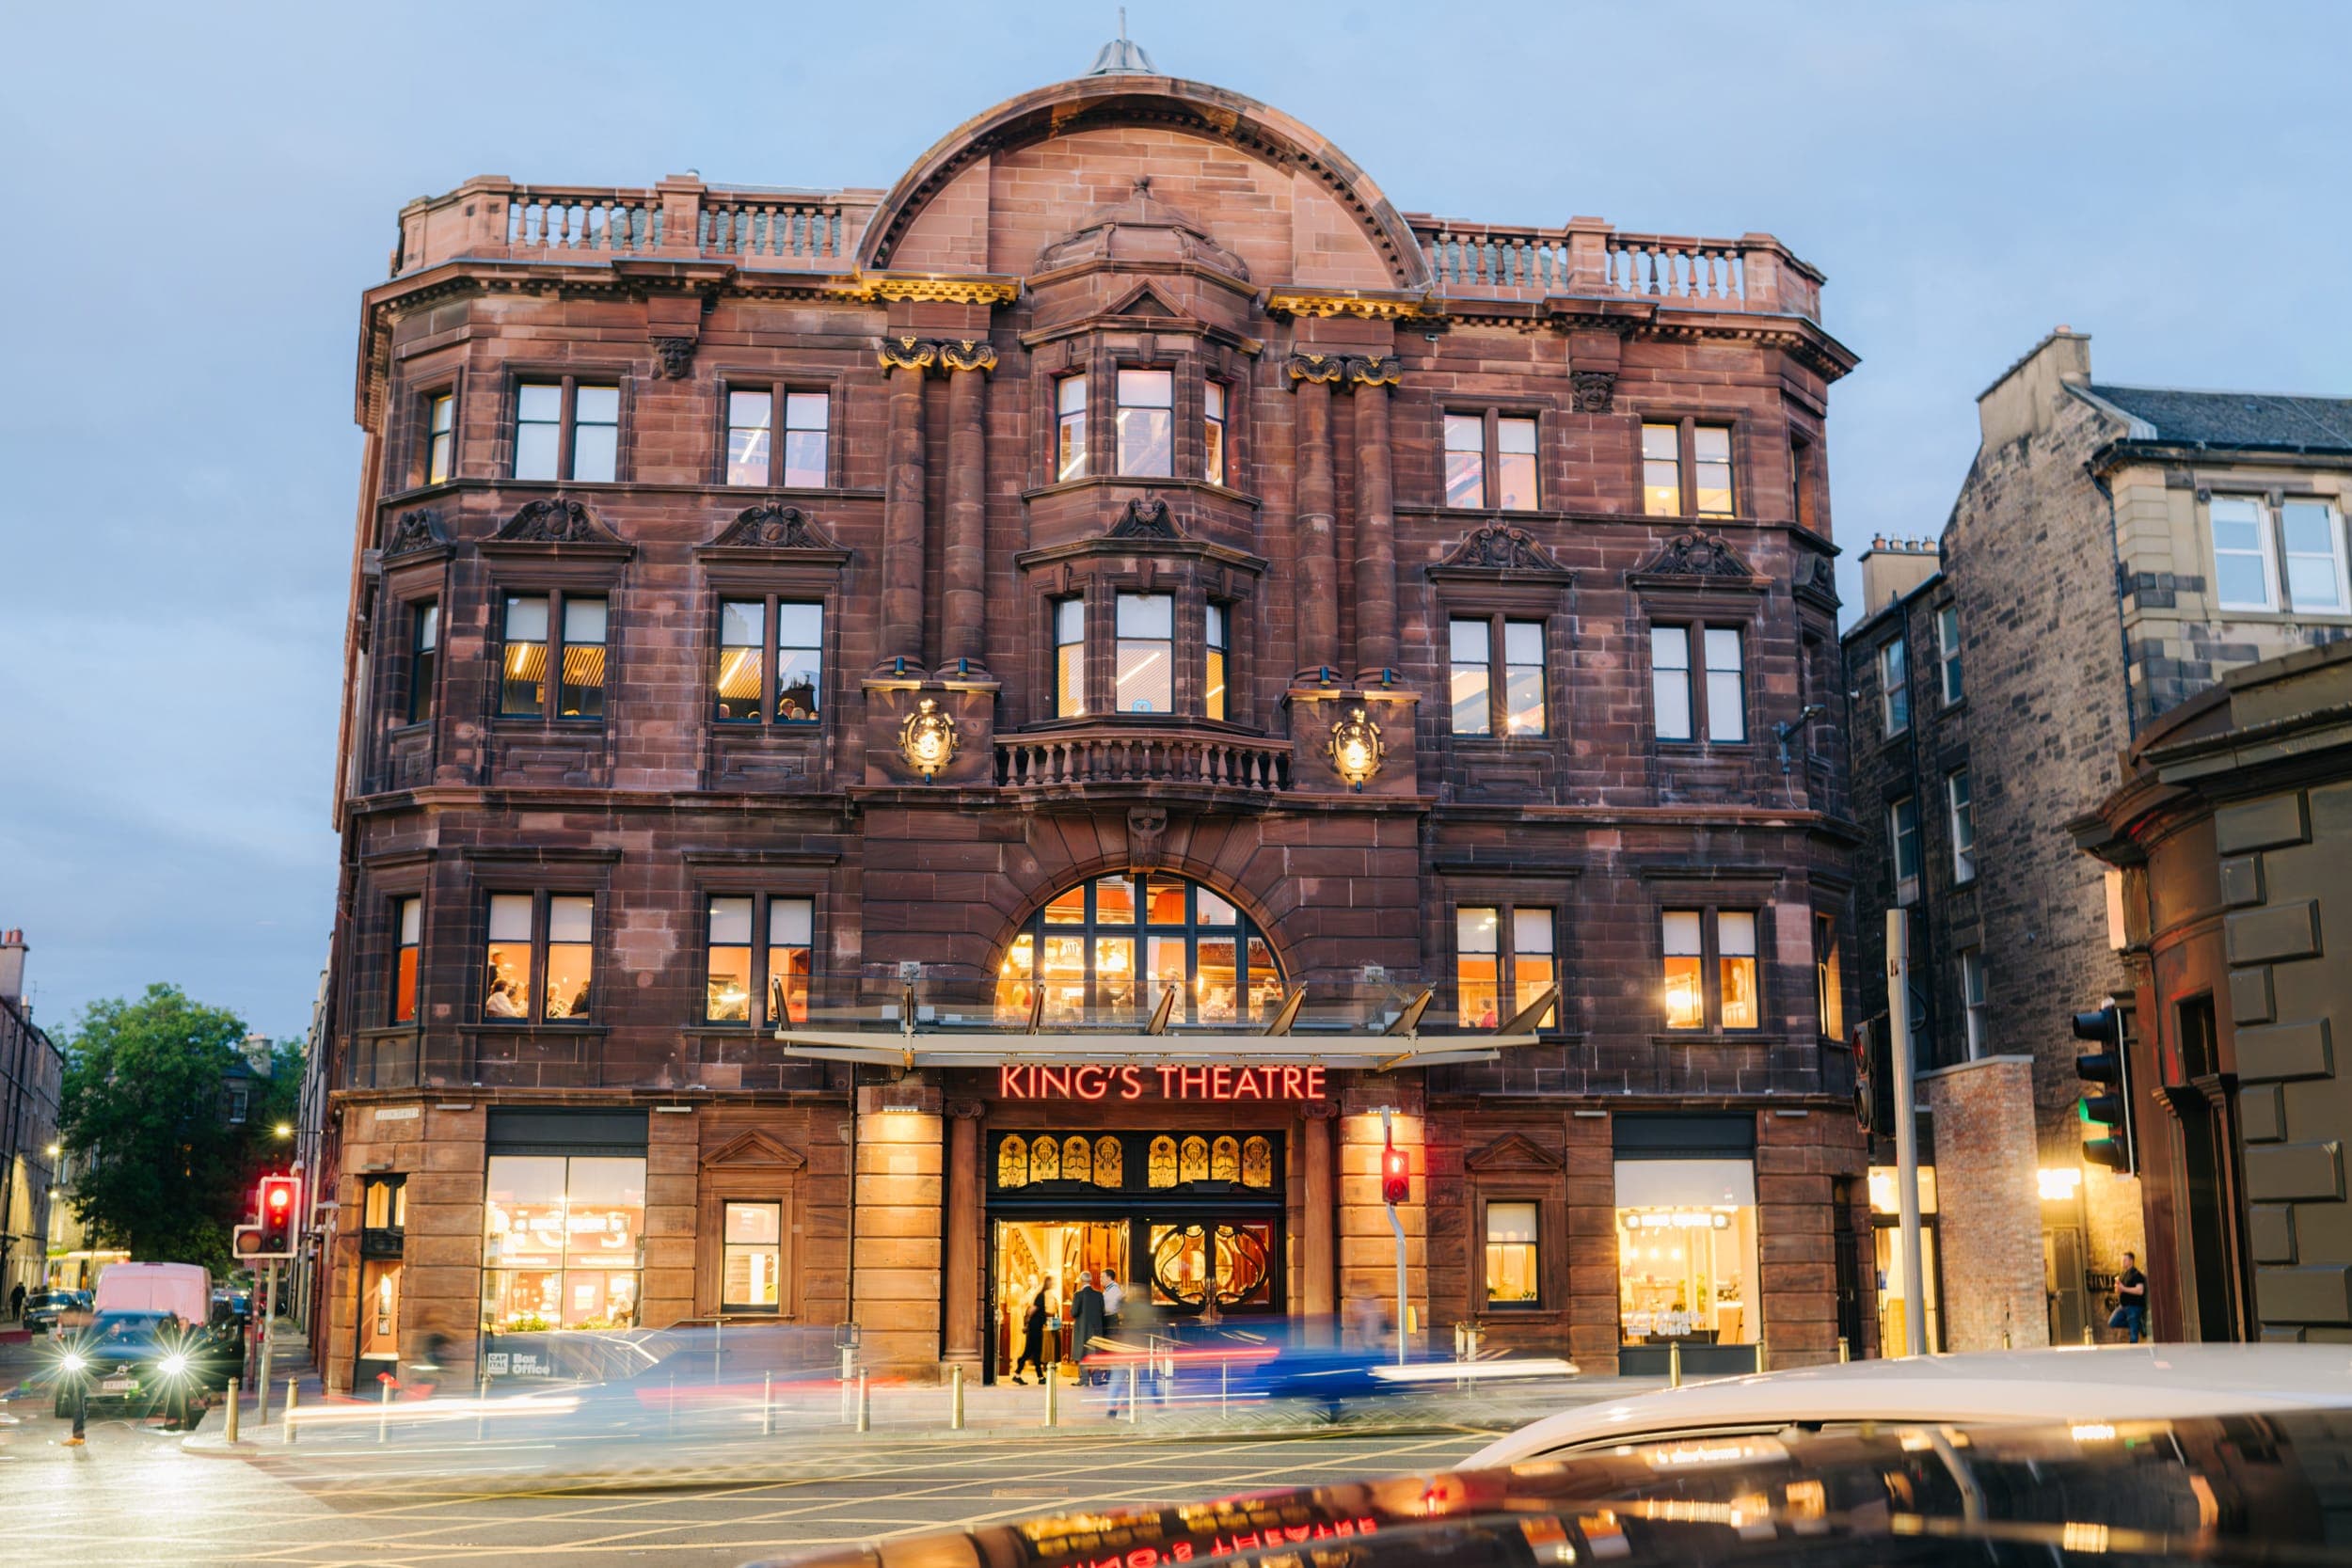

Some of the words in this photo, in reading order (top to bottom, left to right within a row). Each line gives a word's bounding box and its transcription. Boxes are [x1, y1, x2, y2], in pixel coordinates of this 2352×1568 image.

[1001, 1065, 1142, 1100] KING'S
[1155, 1066, 1326, 1100] THEATRE
[513, 1353, 536, 1364] Box
[512, 1364, 549, 1375] Office
